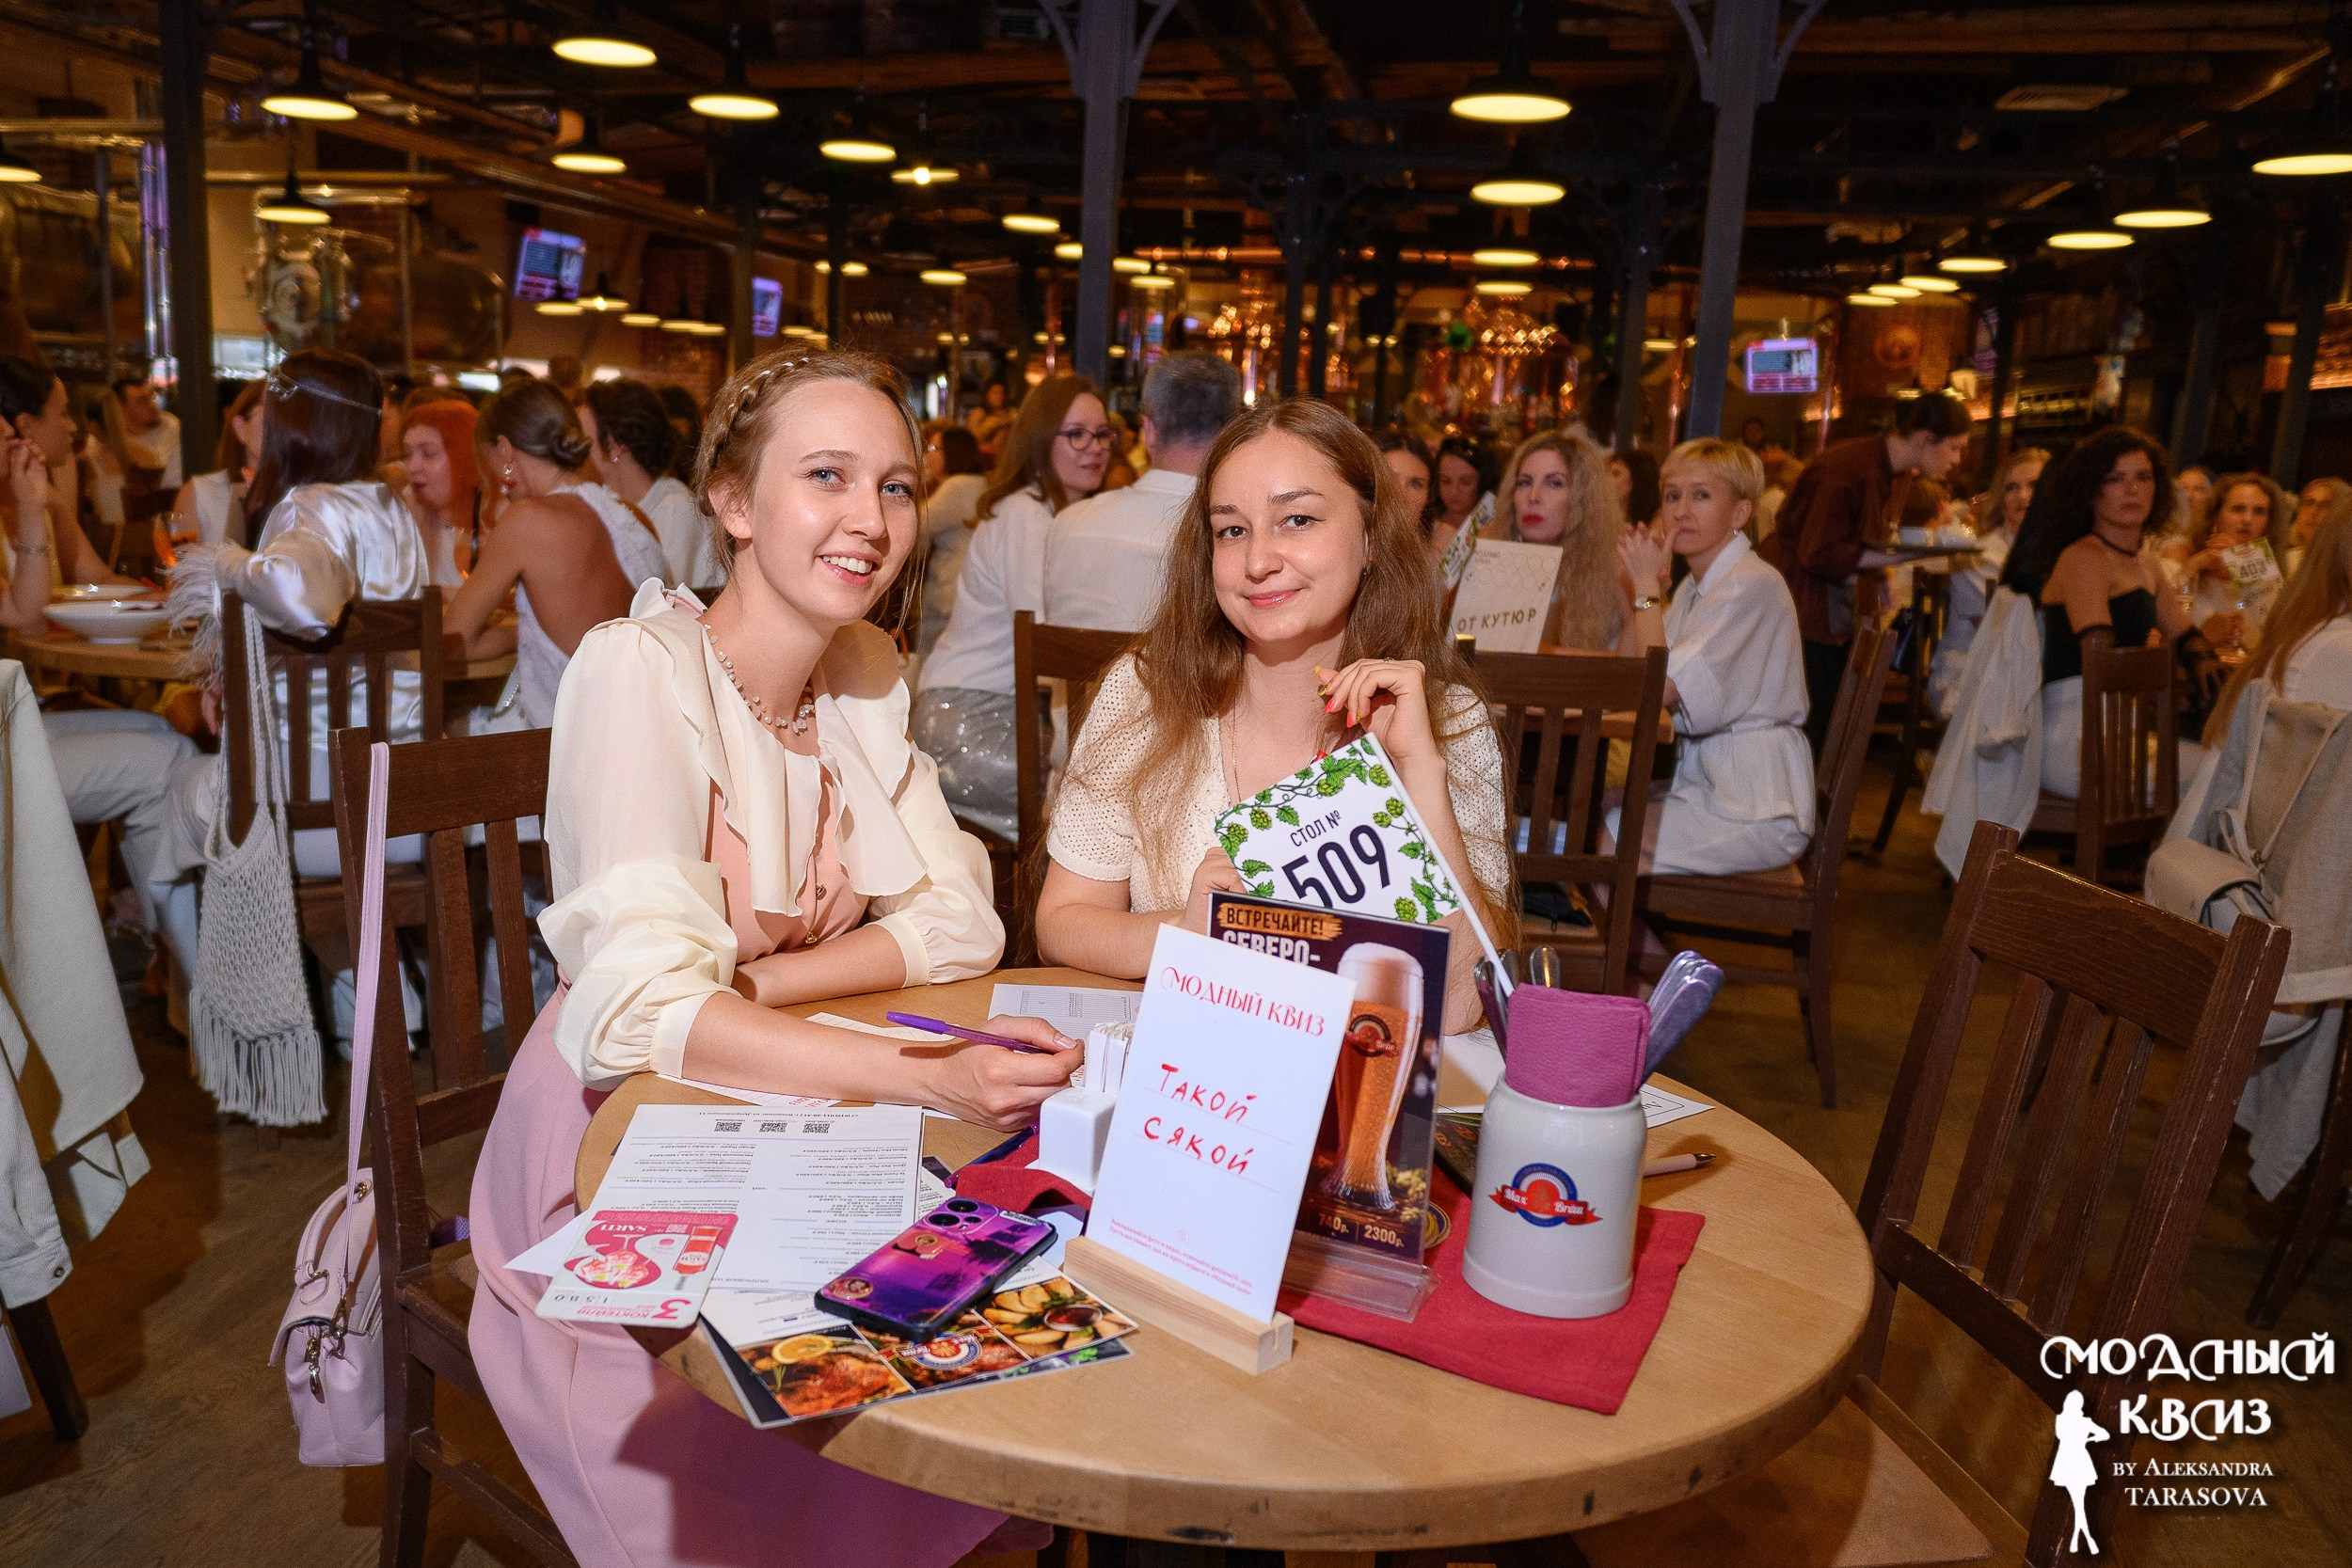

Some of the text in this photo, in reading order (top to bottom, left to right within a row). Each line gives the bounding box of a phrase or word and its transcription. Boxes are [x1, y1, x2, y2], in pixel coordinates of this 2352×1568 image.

[1456, 607, 1537, 633] ОТ КУТЮР
[1290, 809, 1343, 848] СТОЛ №
[1280, 824, 1392, 909] 509
[1227, 907, 1324, 936] ВСТРЕЧАЙТЕ!
[1160, 966, 1263, 1017] МОДНЫЙ
[1267, 1001, 1326, 1037] КВИЗ
[1503, 1187, 1529, 1206] Max
[599, 1224, 648, 1233] SARTI
[574, 1298, 692, 1321] 3 КОКТЕЙЛЯ
